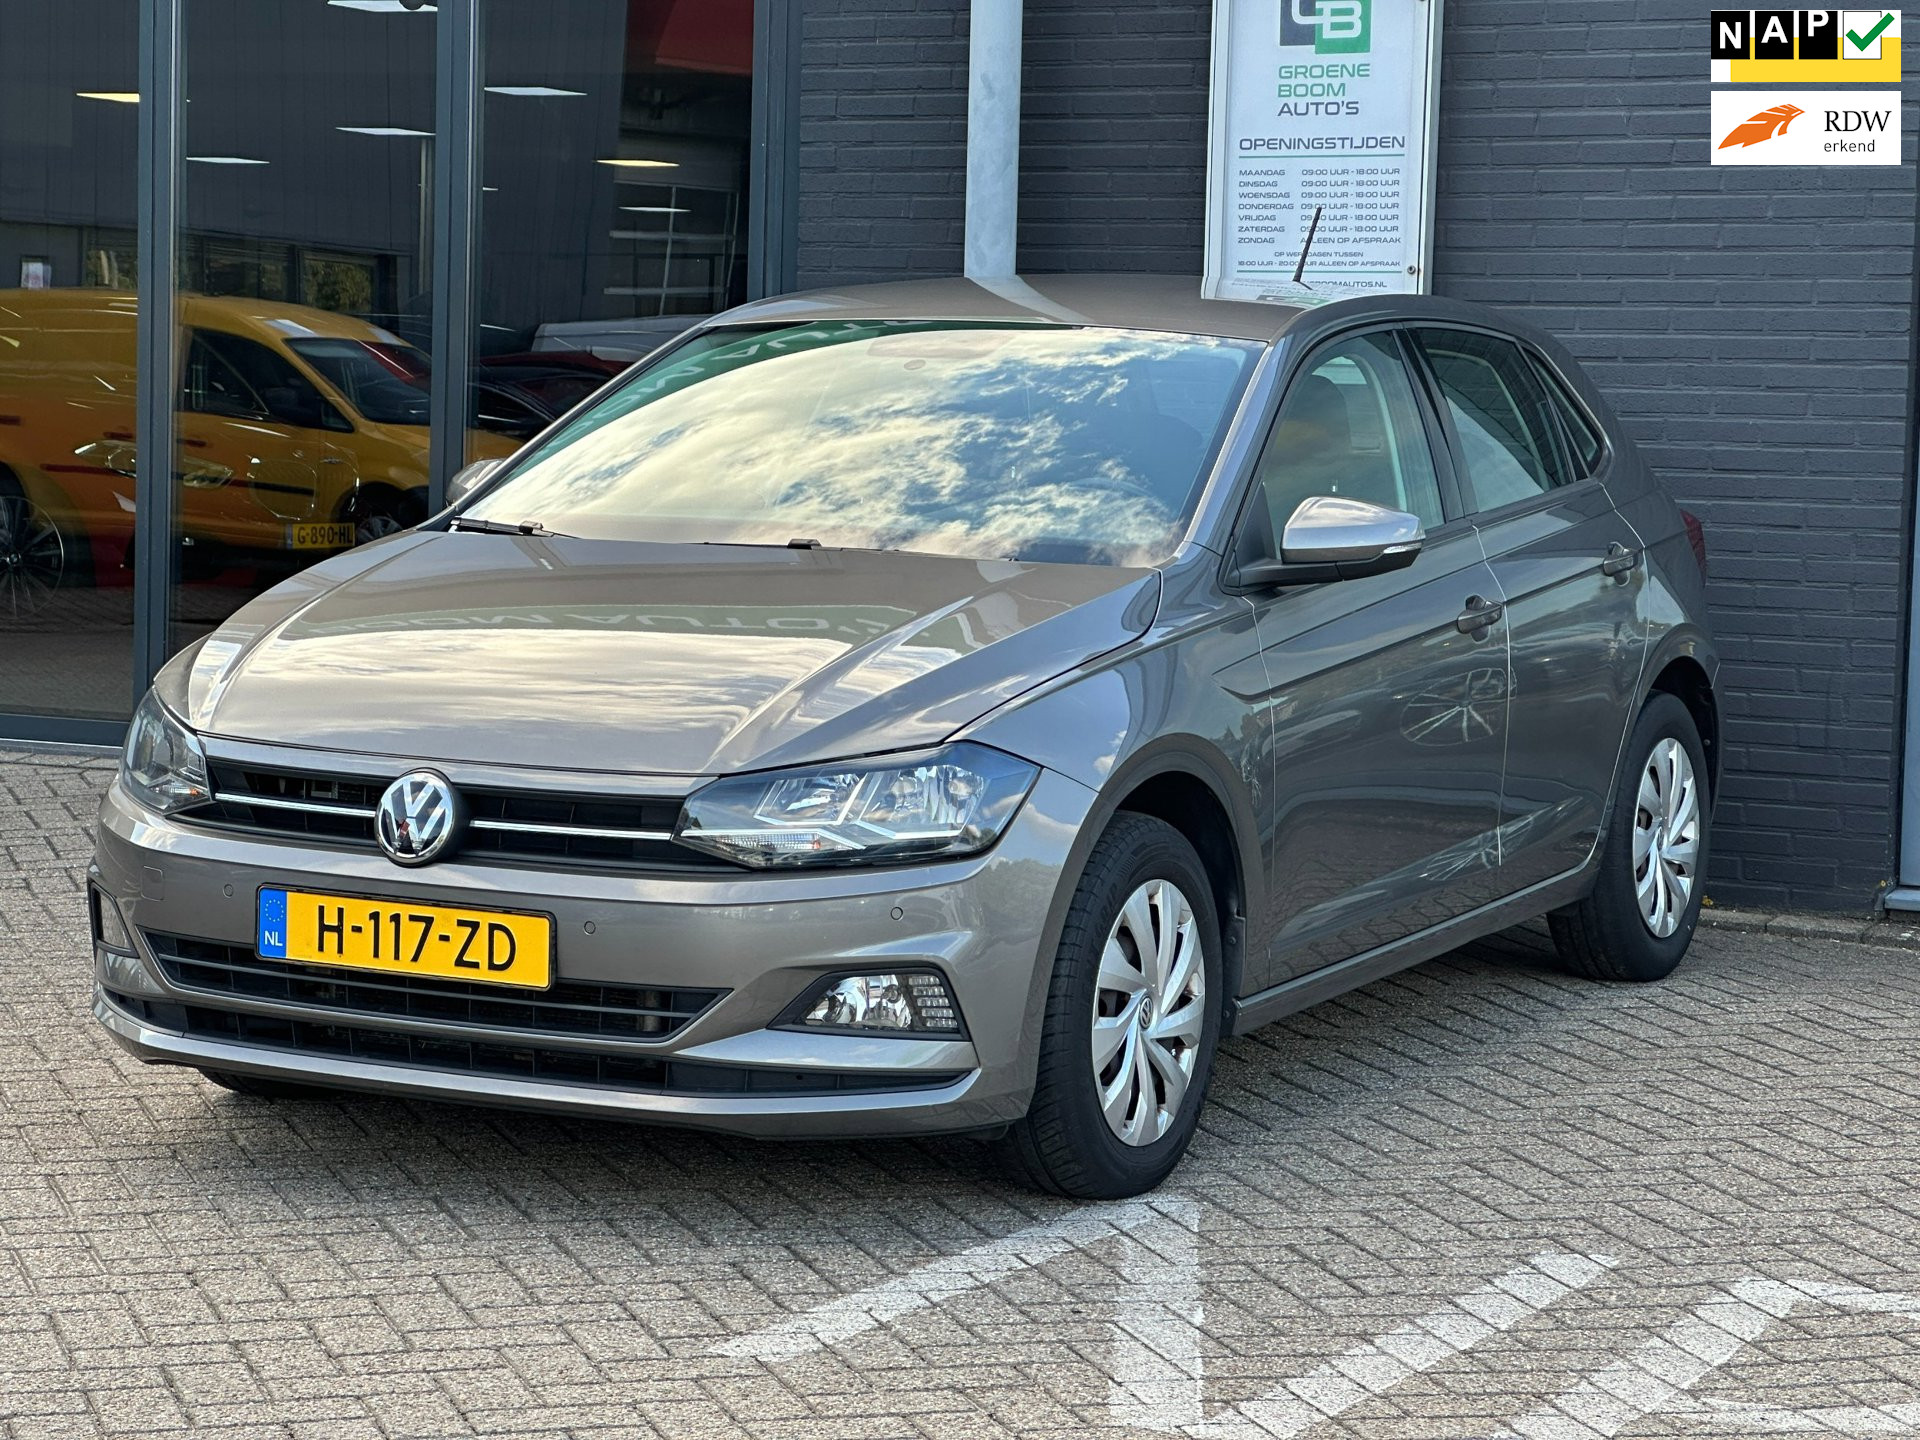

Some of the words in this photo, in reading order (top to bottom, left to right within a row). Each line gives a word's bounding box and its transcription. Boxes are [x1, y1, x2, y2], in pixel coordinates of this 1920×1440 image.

[1278, 63, 1371, 79] GROENE
[1277, 83, 1346, 98] BOOM
[1277, 101, 1360, 117] AUTO'S
[1239, 136, 1406, 151] OPENINGSTIJDEN
[297, 525, 353, 545] G-890-HL
[264, 931, 284, 948] NL
[317, 904, 517, 972] H-117-ZD
